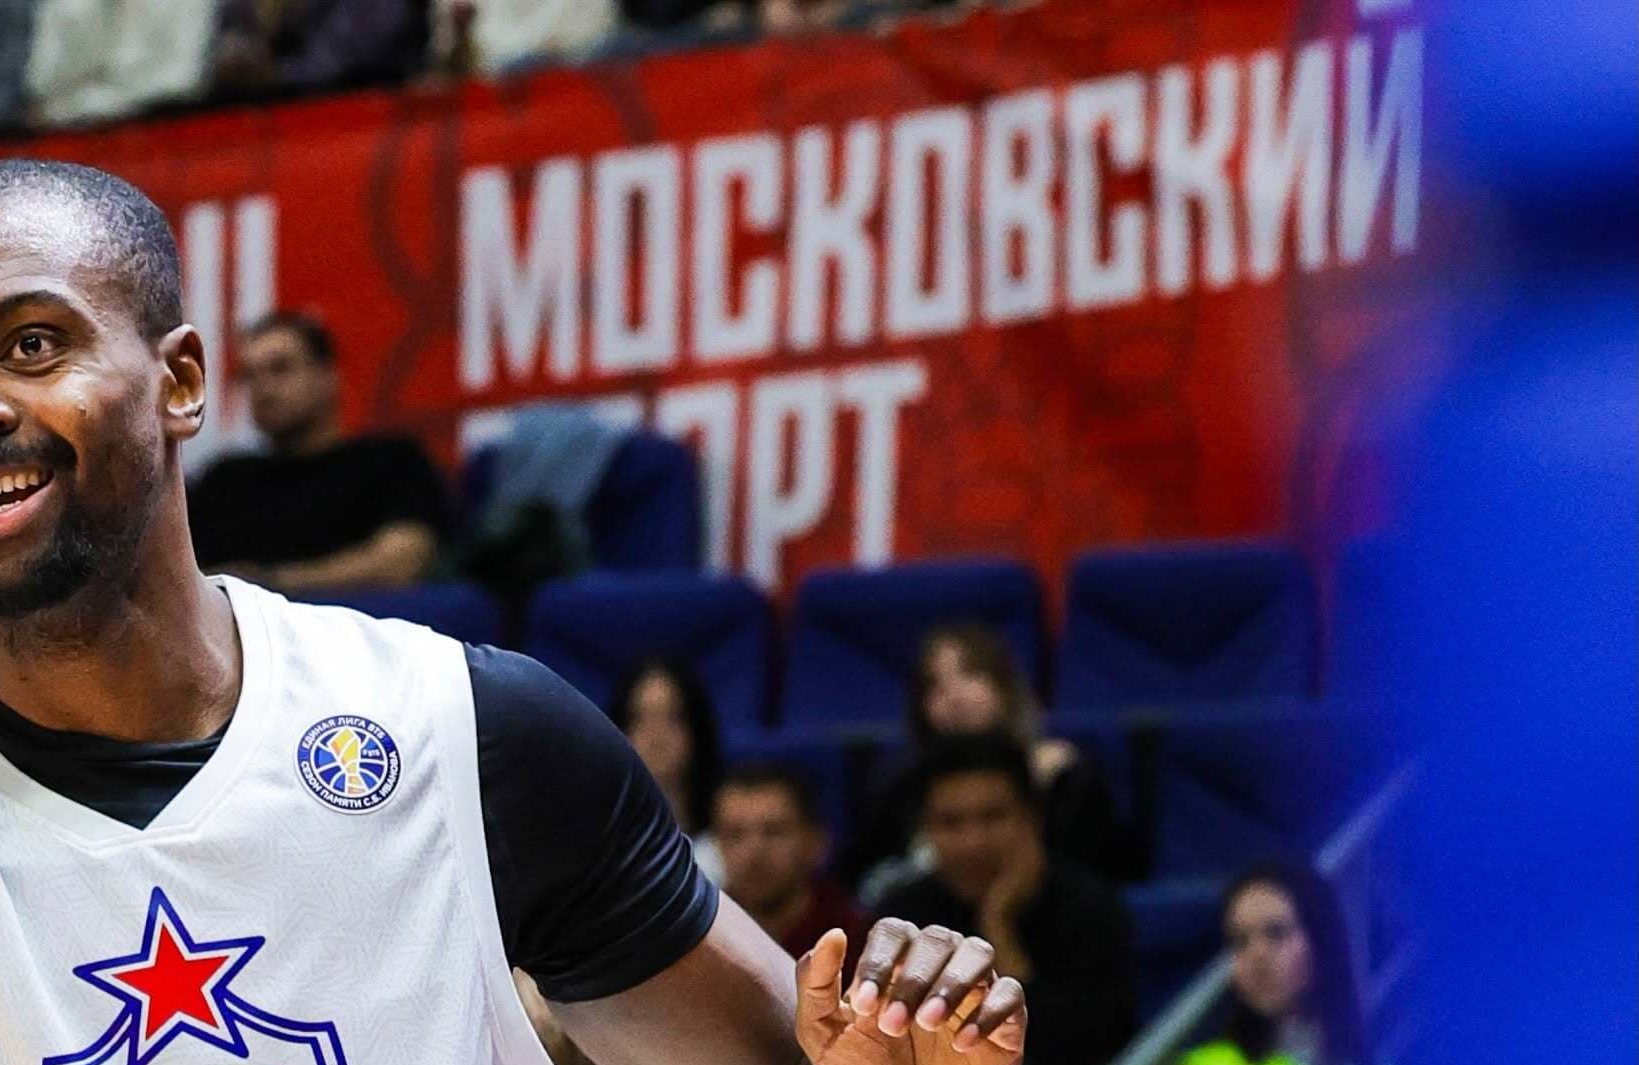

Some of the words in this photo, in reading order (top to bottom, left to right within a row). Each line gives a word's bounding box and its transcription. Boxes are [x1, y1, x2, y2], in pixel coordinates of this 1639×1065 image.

[458, 0, 1424, 390] МОСКОВСКИЙ
[301, 719, 336, 749] ЕДИНАЯ
[337, 717, 366, 728] ЛИГА
[367, 723, 386, 739] ВТБ
[301, 761, 322, 793] СЕЗОН
[320, 789, 362, 809] ПАМЯТИ
[379, 750, 399, 797] ИВАНОВА
